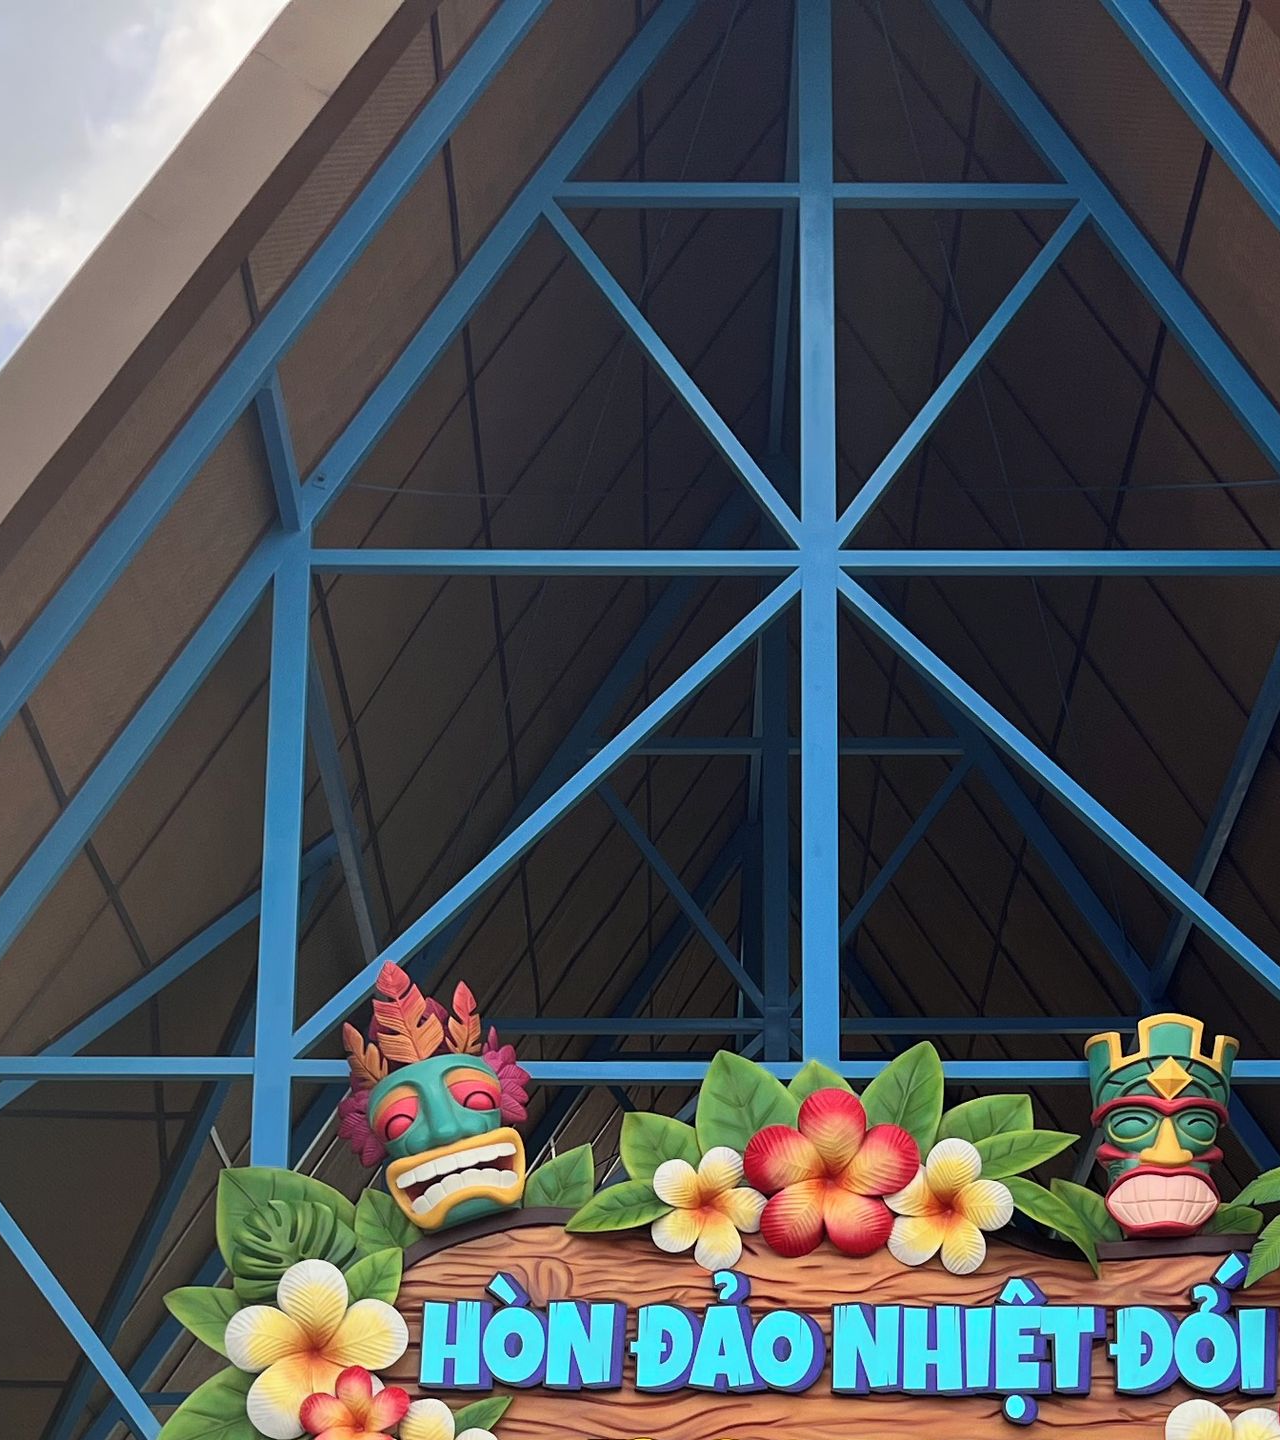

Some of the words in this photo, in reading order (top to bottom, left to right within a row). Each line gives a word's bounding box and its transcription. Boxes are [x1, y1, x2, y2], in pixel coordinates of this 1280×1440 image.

[419, 1272, 627, 1391] HÒN
[631, 1270, 826, 1393] ĐẢO
[831, 1277, 1108, 1424] NHIỆT
